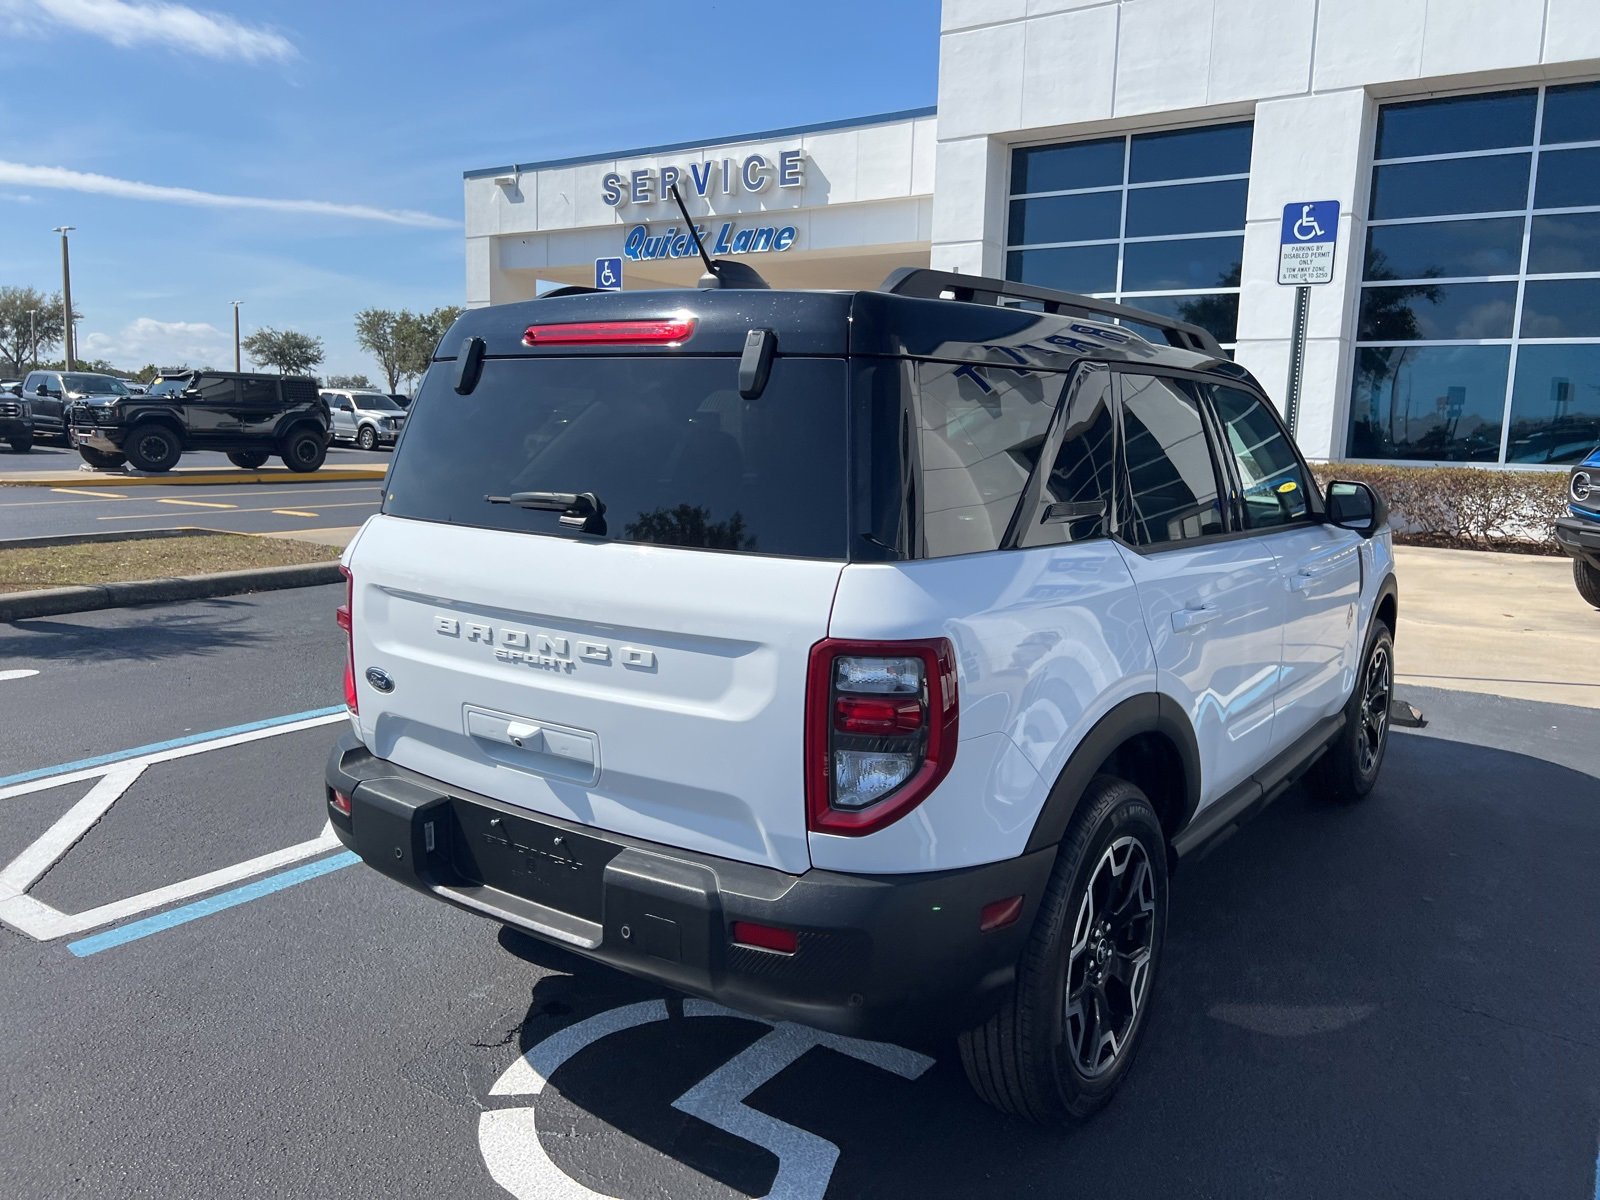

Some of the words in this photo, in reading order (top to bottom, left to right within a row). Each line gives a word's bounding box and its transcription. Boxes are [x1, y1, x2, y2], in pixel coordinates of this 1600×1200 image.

[601, 149, 804, 207] SERVICE
[623, 224, 707, 262] Quick
[712, 221, 798, 255] Lane
[433, 615, 656, 670] BRONCO
[494, 647, 575, 672] SPORT
